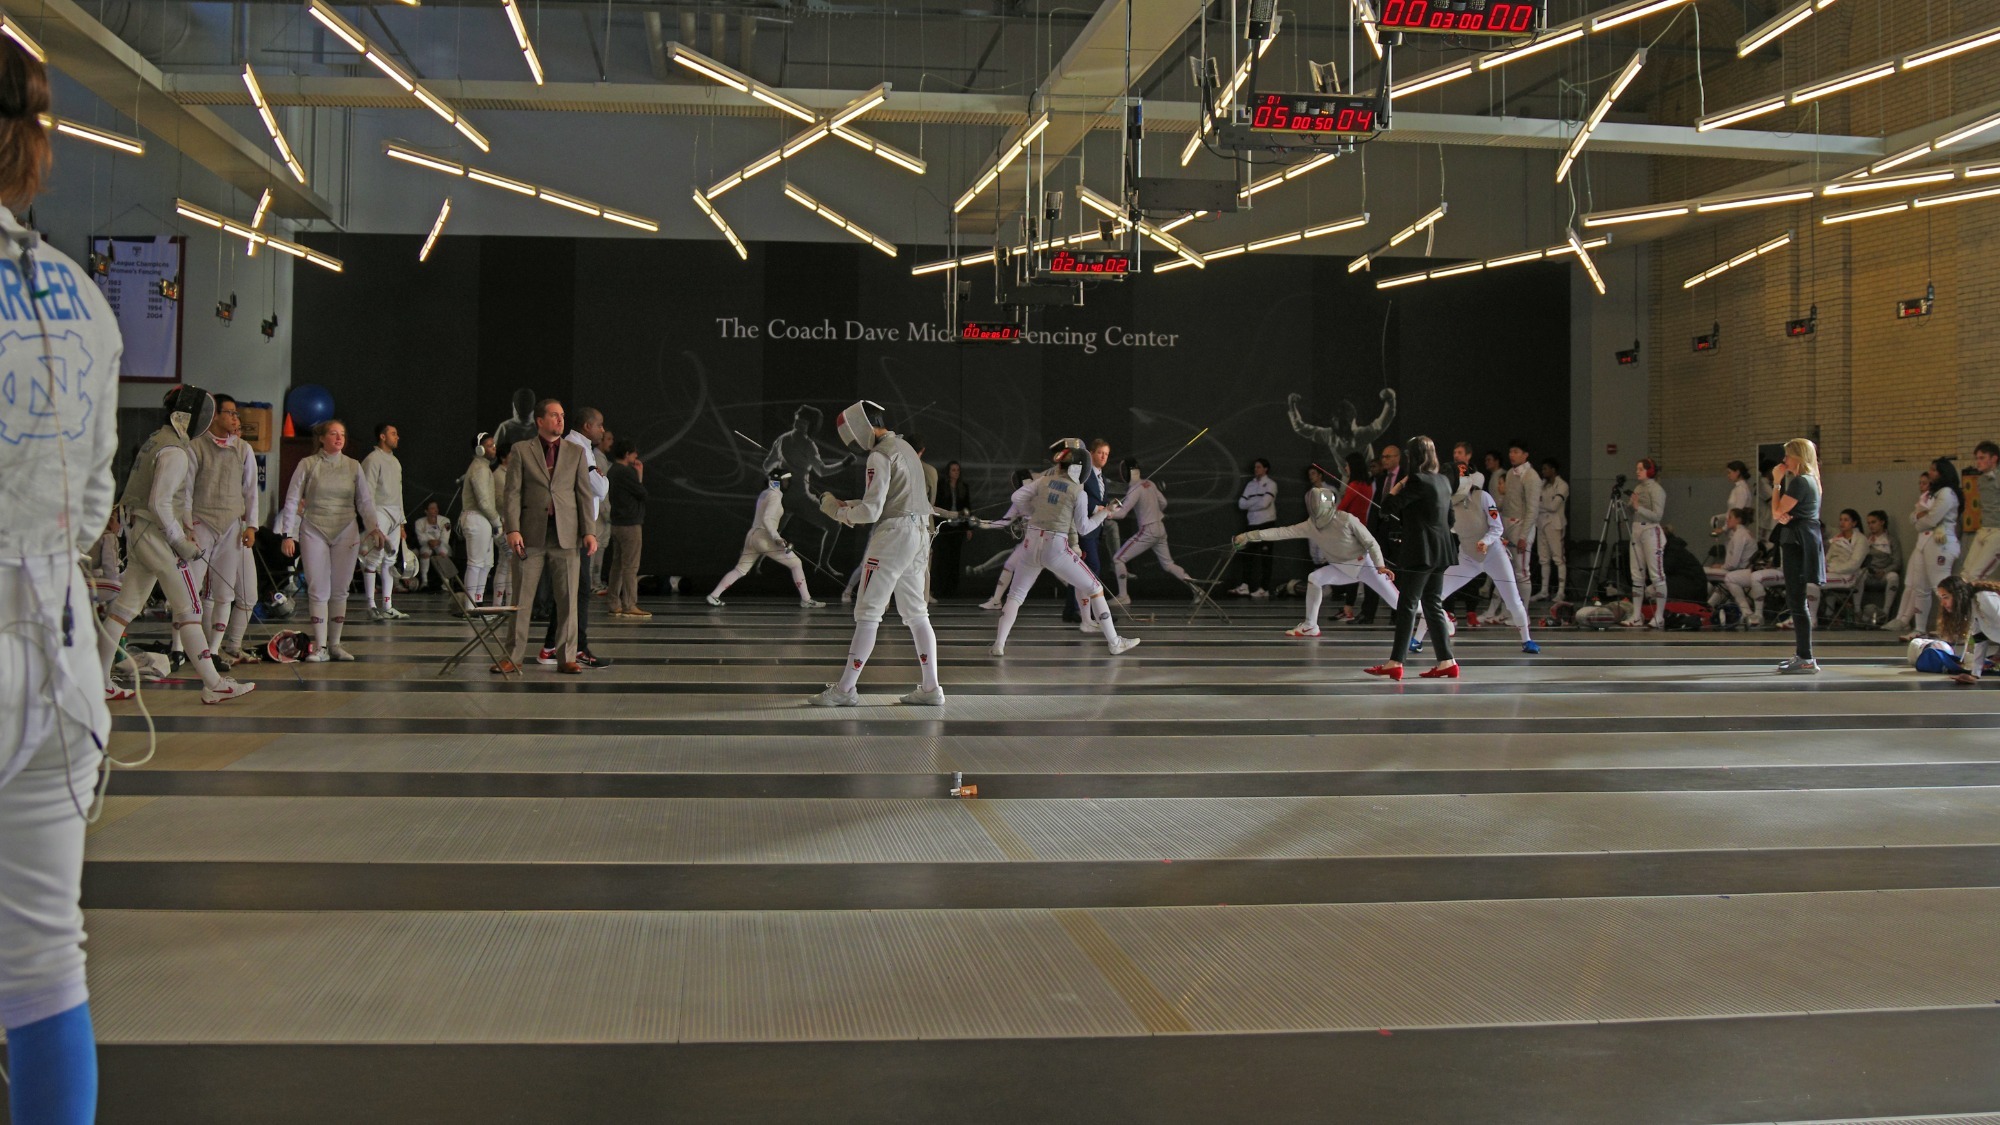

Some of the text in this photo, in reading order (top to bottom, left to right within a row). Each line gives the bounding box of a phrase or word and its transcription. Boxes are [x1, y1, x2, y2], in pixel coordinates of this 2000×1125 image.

[1382, 0, 1533, 31] 00 03:00 00
[1254, 106, 1373, 131] 05 00:50 04
[1052, 258, 1075, 271] 02
[1105, 258, 1128, 272] 02
[716, 317, 759, 339] The
[768, 318, 838, 341] Coach
[845, 320, 900, 341] Dave
[1026, 327, 1098, 354] encing
[1105, 326, 1179, 347] Center
[963, 327, 980, 338] 00
[1001, 328, 1019, 338] 01
[1876, 480, 1883, 496] 3
